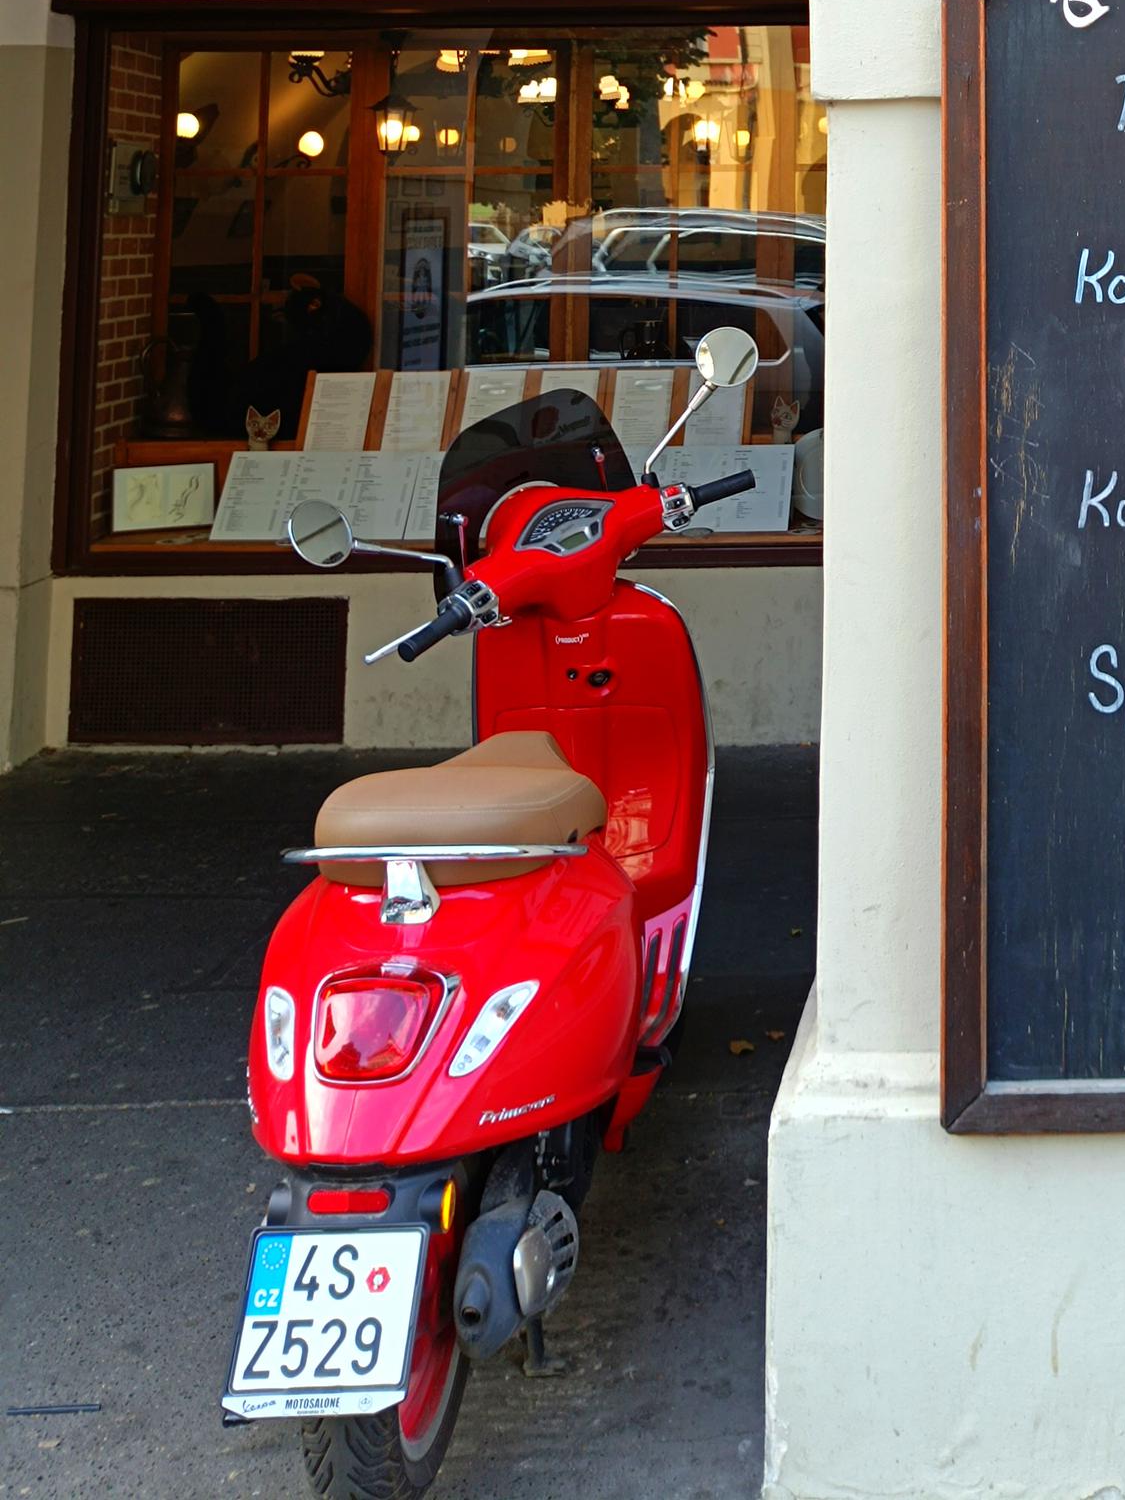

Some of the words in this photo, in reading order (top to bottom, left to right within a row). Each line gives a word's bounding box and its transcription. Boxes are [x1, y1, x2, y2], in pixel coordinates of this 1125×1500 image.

[293, 1243, 359, 1302] 4S
[254, 1288, 280, 1308] CZ
[242, 1316, 383, 1380] Z529
[285, 1397, 341, 1409] MOTOSALONE
